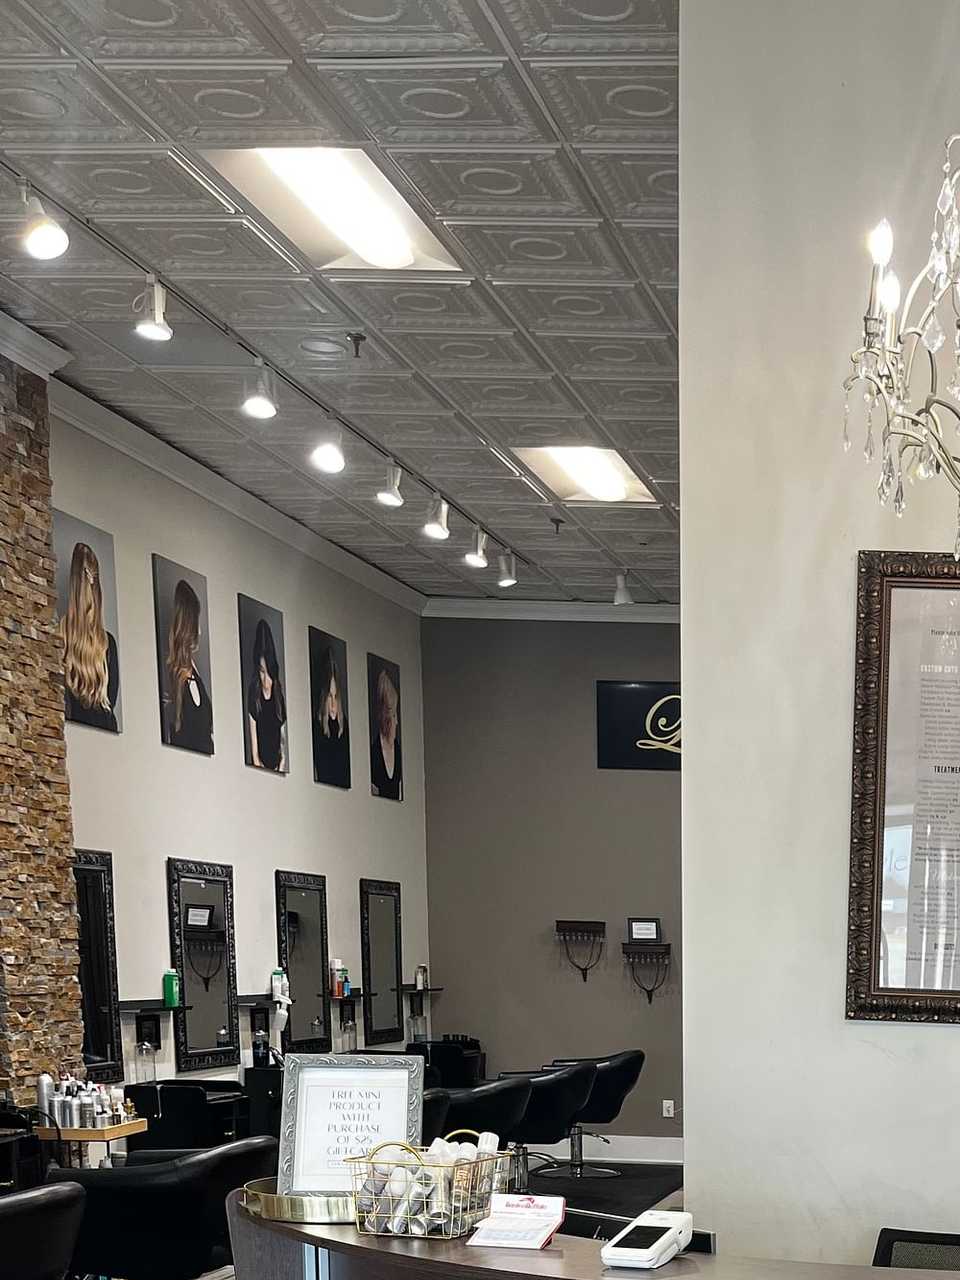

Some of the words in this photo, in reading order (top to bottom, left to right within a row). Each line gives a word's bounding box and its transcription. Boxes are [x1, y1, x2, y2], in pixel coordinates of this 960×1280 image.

[331, 1089, 353, 1100] FREE
[357, 1089, 382, 1100] MINI
[329, 1101, 381, 1111] PRODUCT
[341, 1113, 371, 1122] WITH
[326, 1123, 381, 1134] PURCHASE
[336, 1135, 351, 1145] OF
